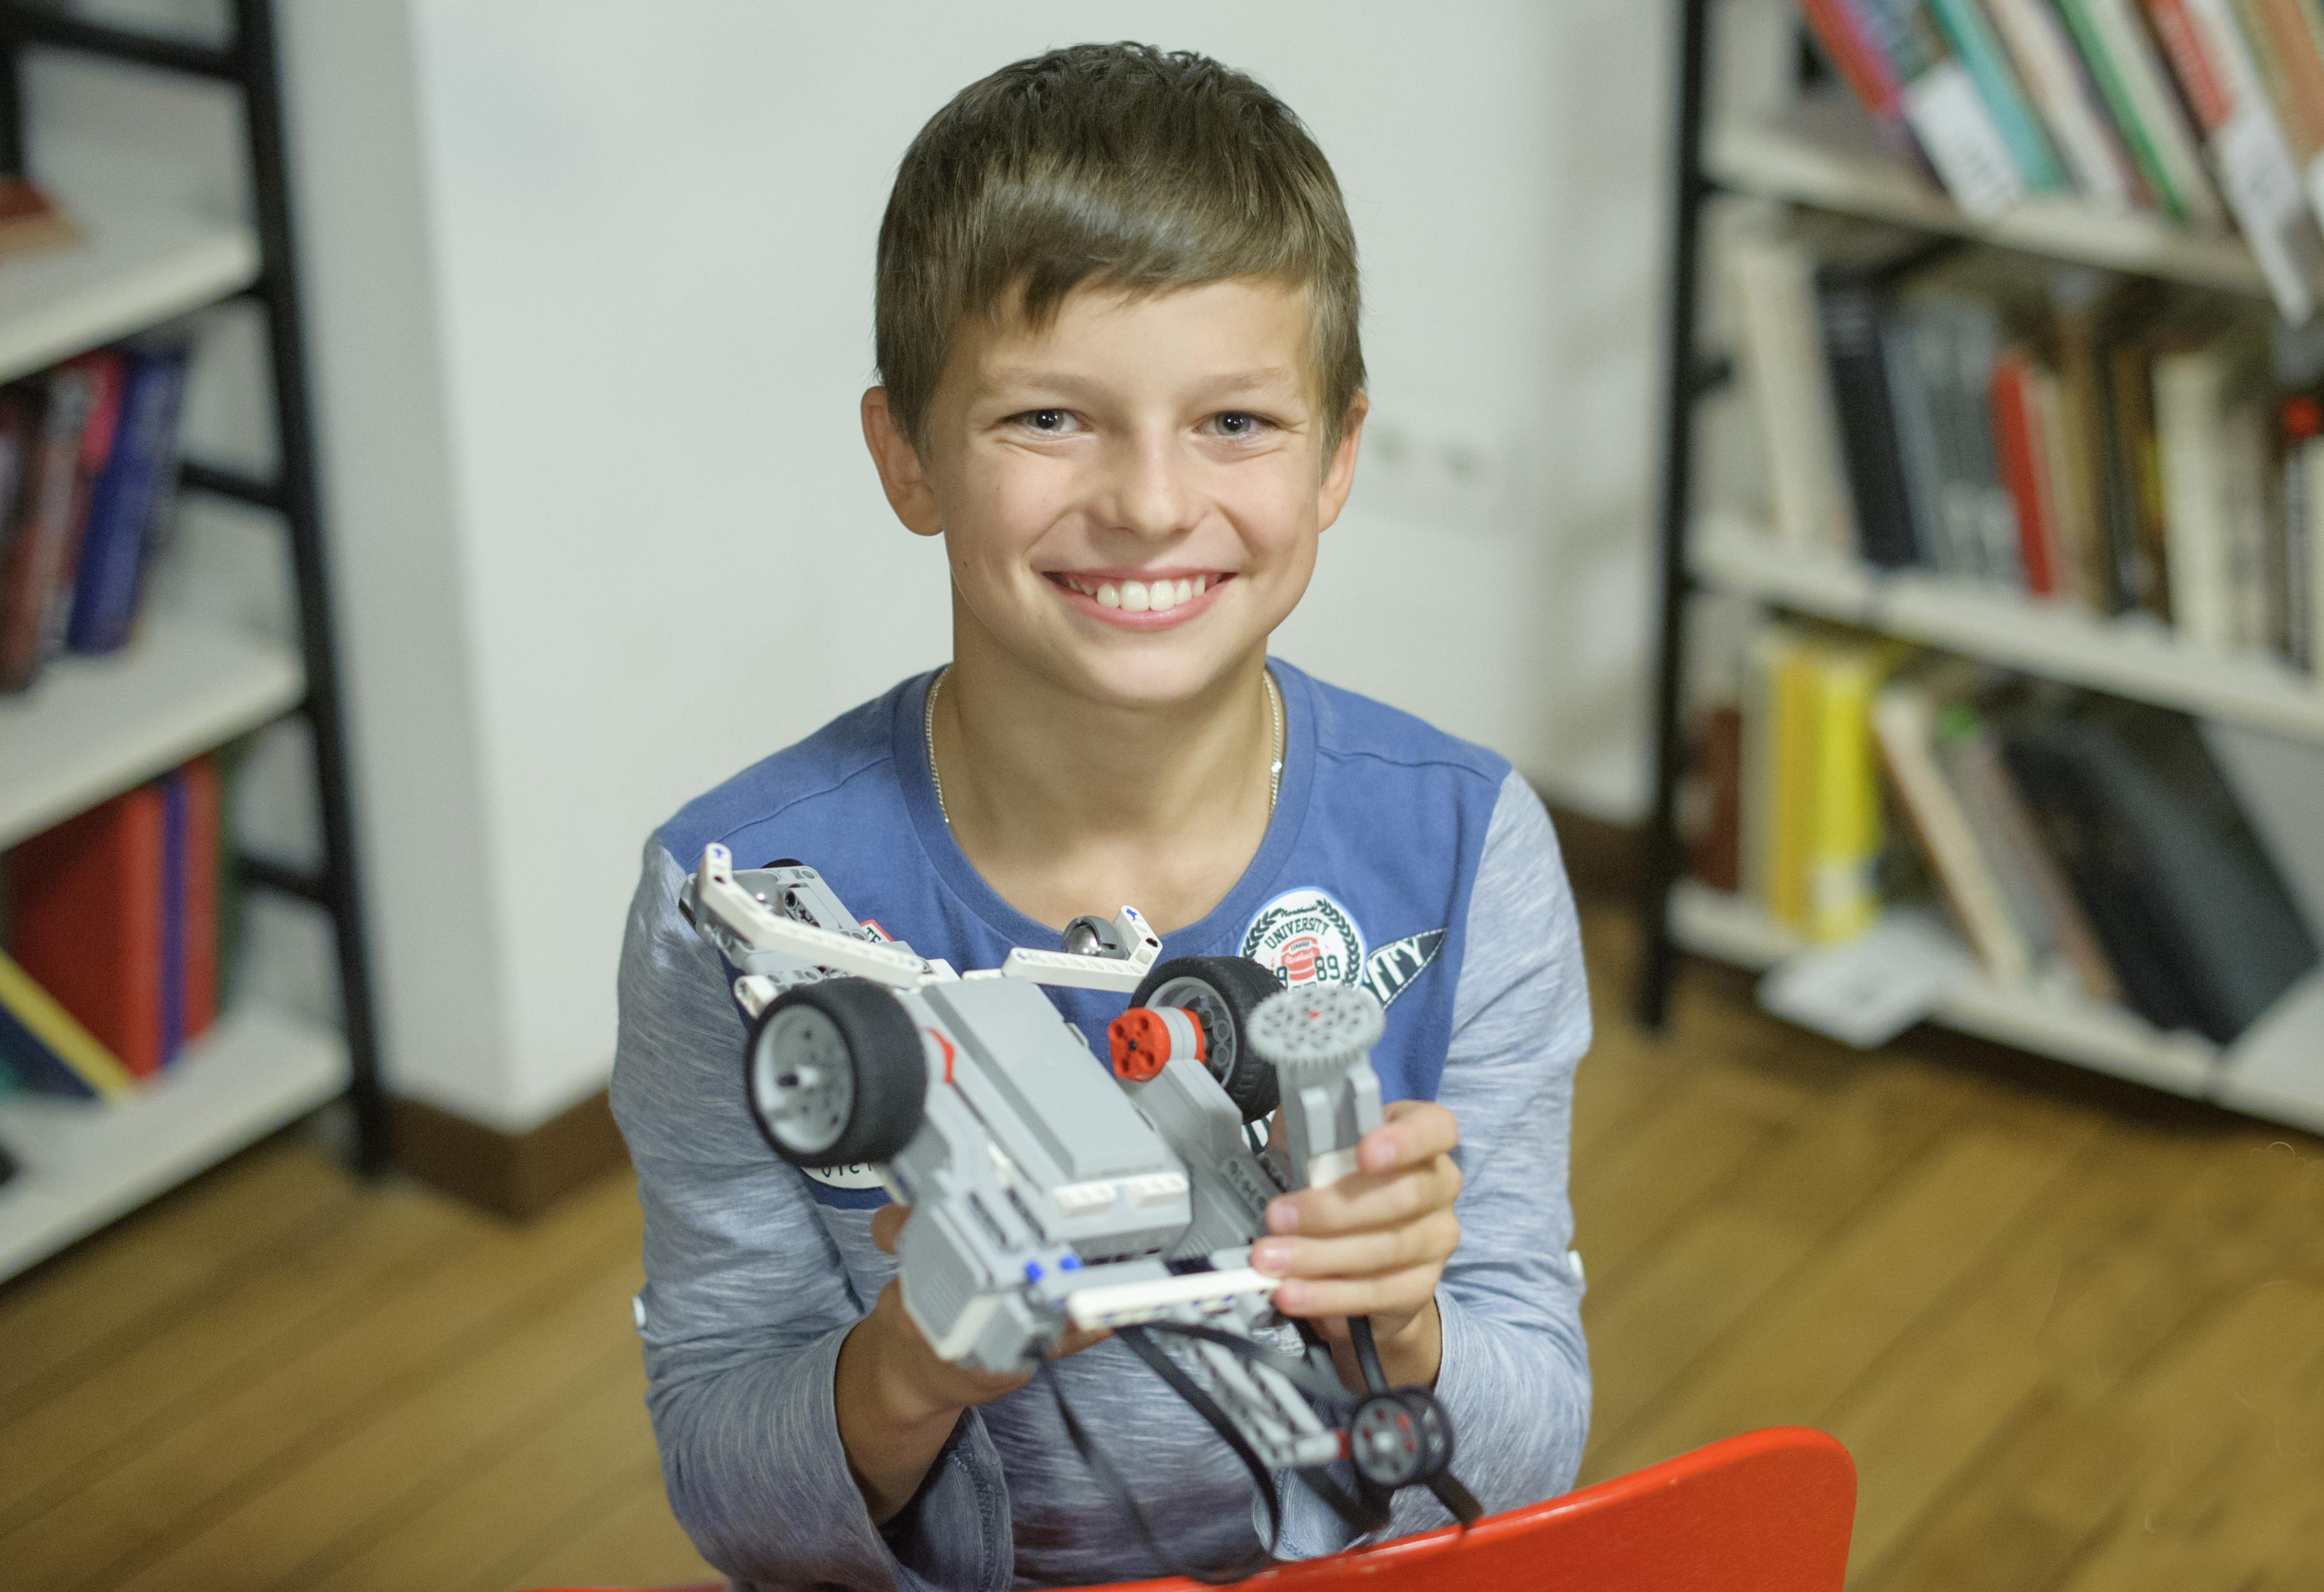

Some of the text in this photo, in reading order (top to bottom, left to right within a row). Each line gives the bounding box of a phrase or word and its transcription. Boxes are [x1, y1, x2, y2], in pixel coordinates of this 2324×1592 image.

[1264, 918, 1329, 949] UNIVERSITY
[1276, 966, 1288, 989] 9
[1314, 955, 1340, 981] 89
[1364, 936, 1424, 1002] ITY
